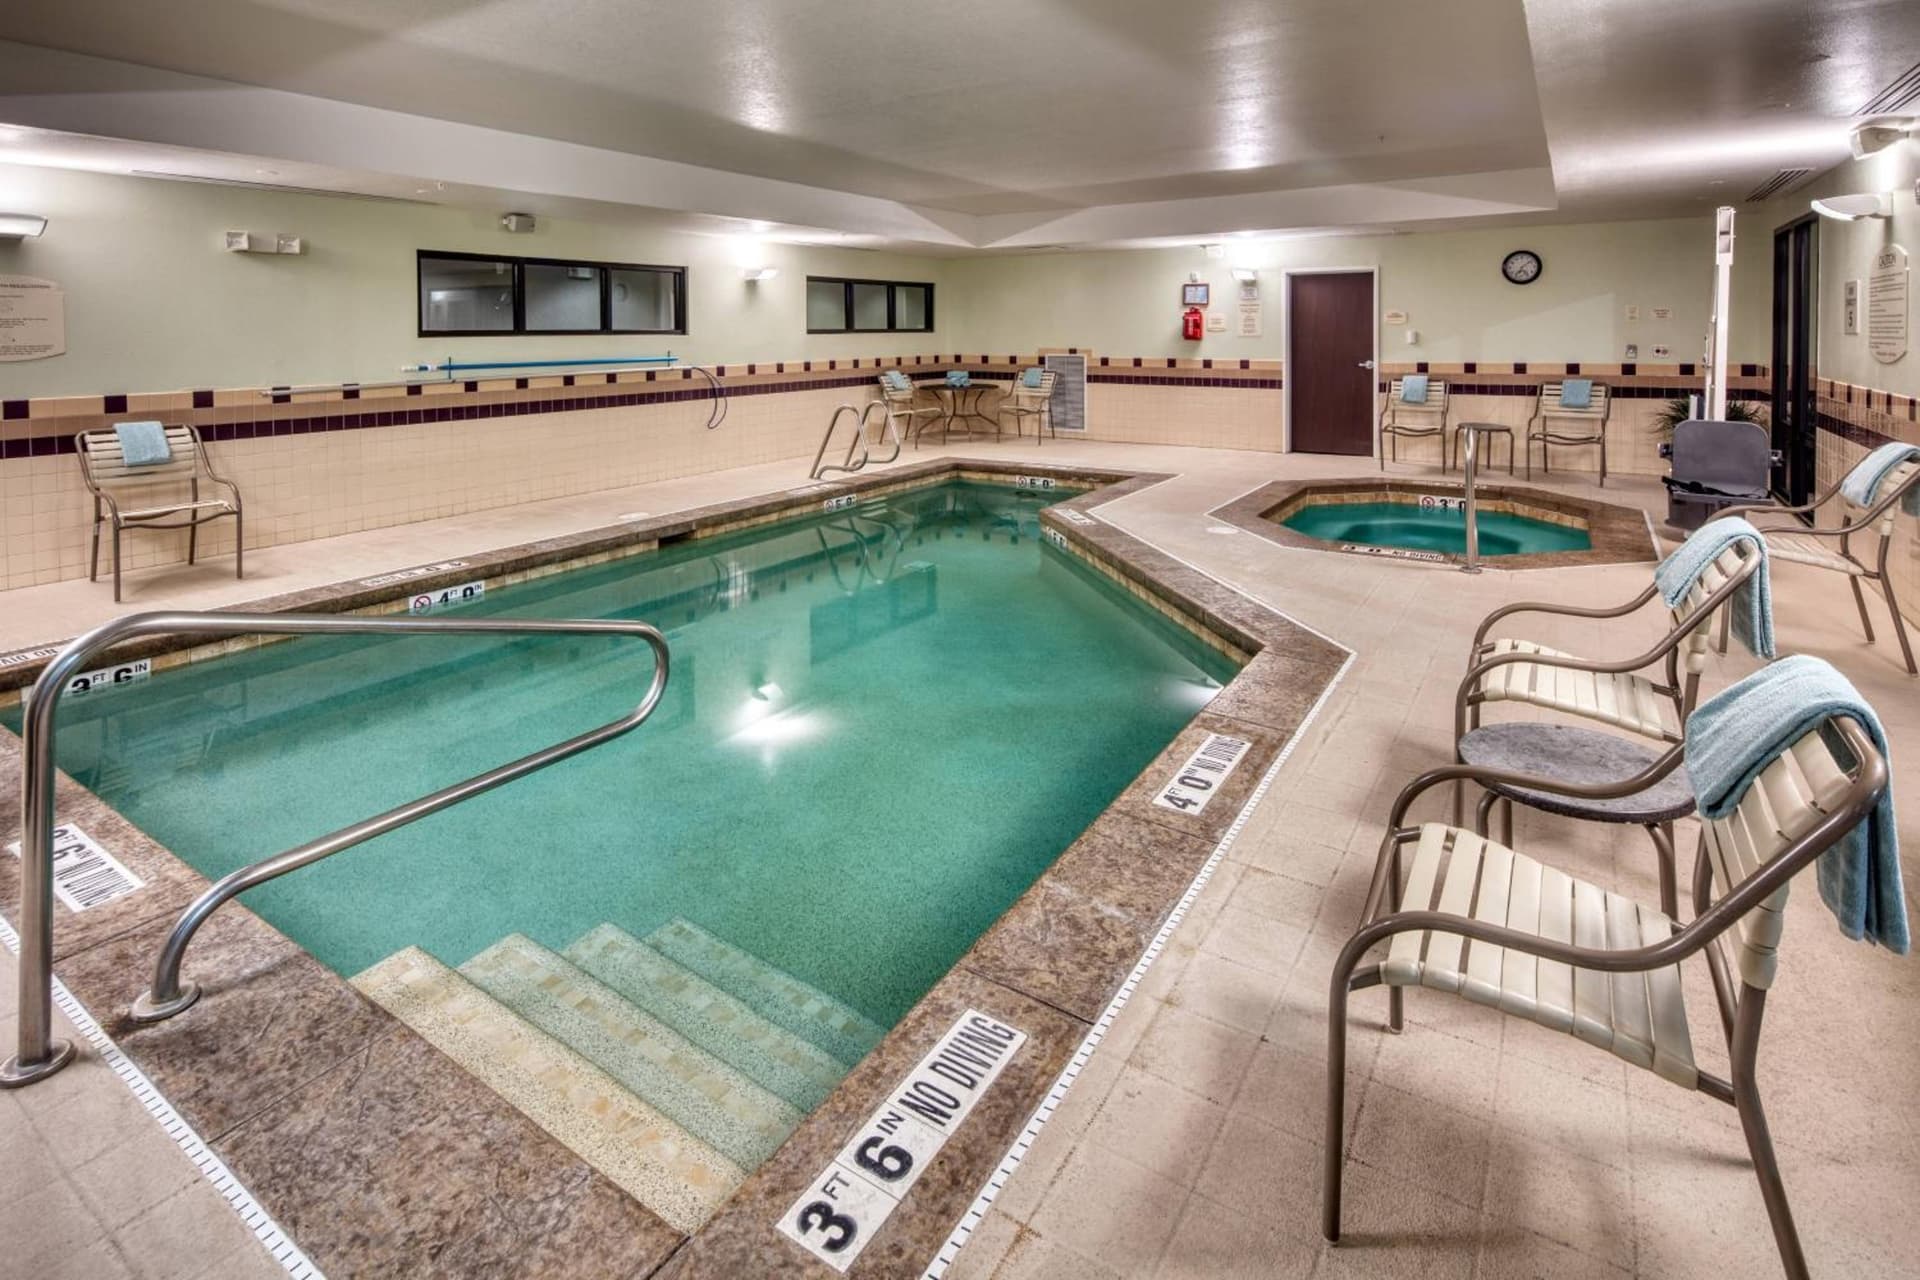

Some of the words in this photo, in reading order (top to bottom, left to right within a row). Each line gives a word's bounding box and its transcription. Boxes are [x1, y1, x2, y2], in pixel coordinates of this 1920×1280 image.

[440, 591, 449, 603] 4
[71, 677, 91, 693] 3
[92, 672, 107, 683] FT
[134, 662, 148, 673] IN
[1163, 794, 1199, 810] 4
[929, 1016, 1017, 1091] DIVING
[898, 1080, 961, 1127] NO
[876, 1110, 905, 1136] IN
[854, 1135, 914, 1183] 6
[821, 1170, 850, 1201] FT
[796, 1200, 858, 1253] 3
